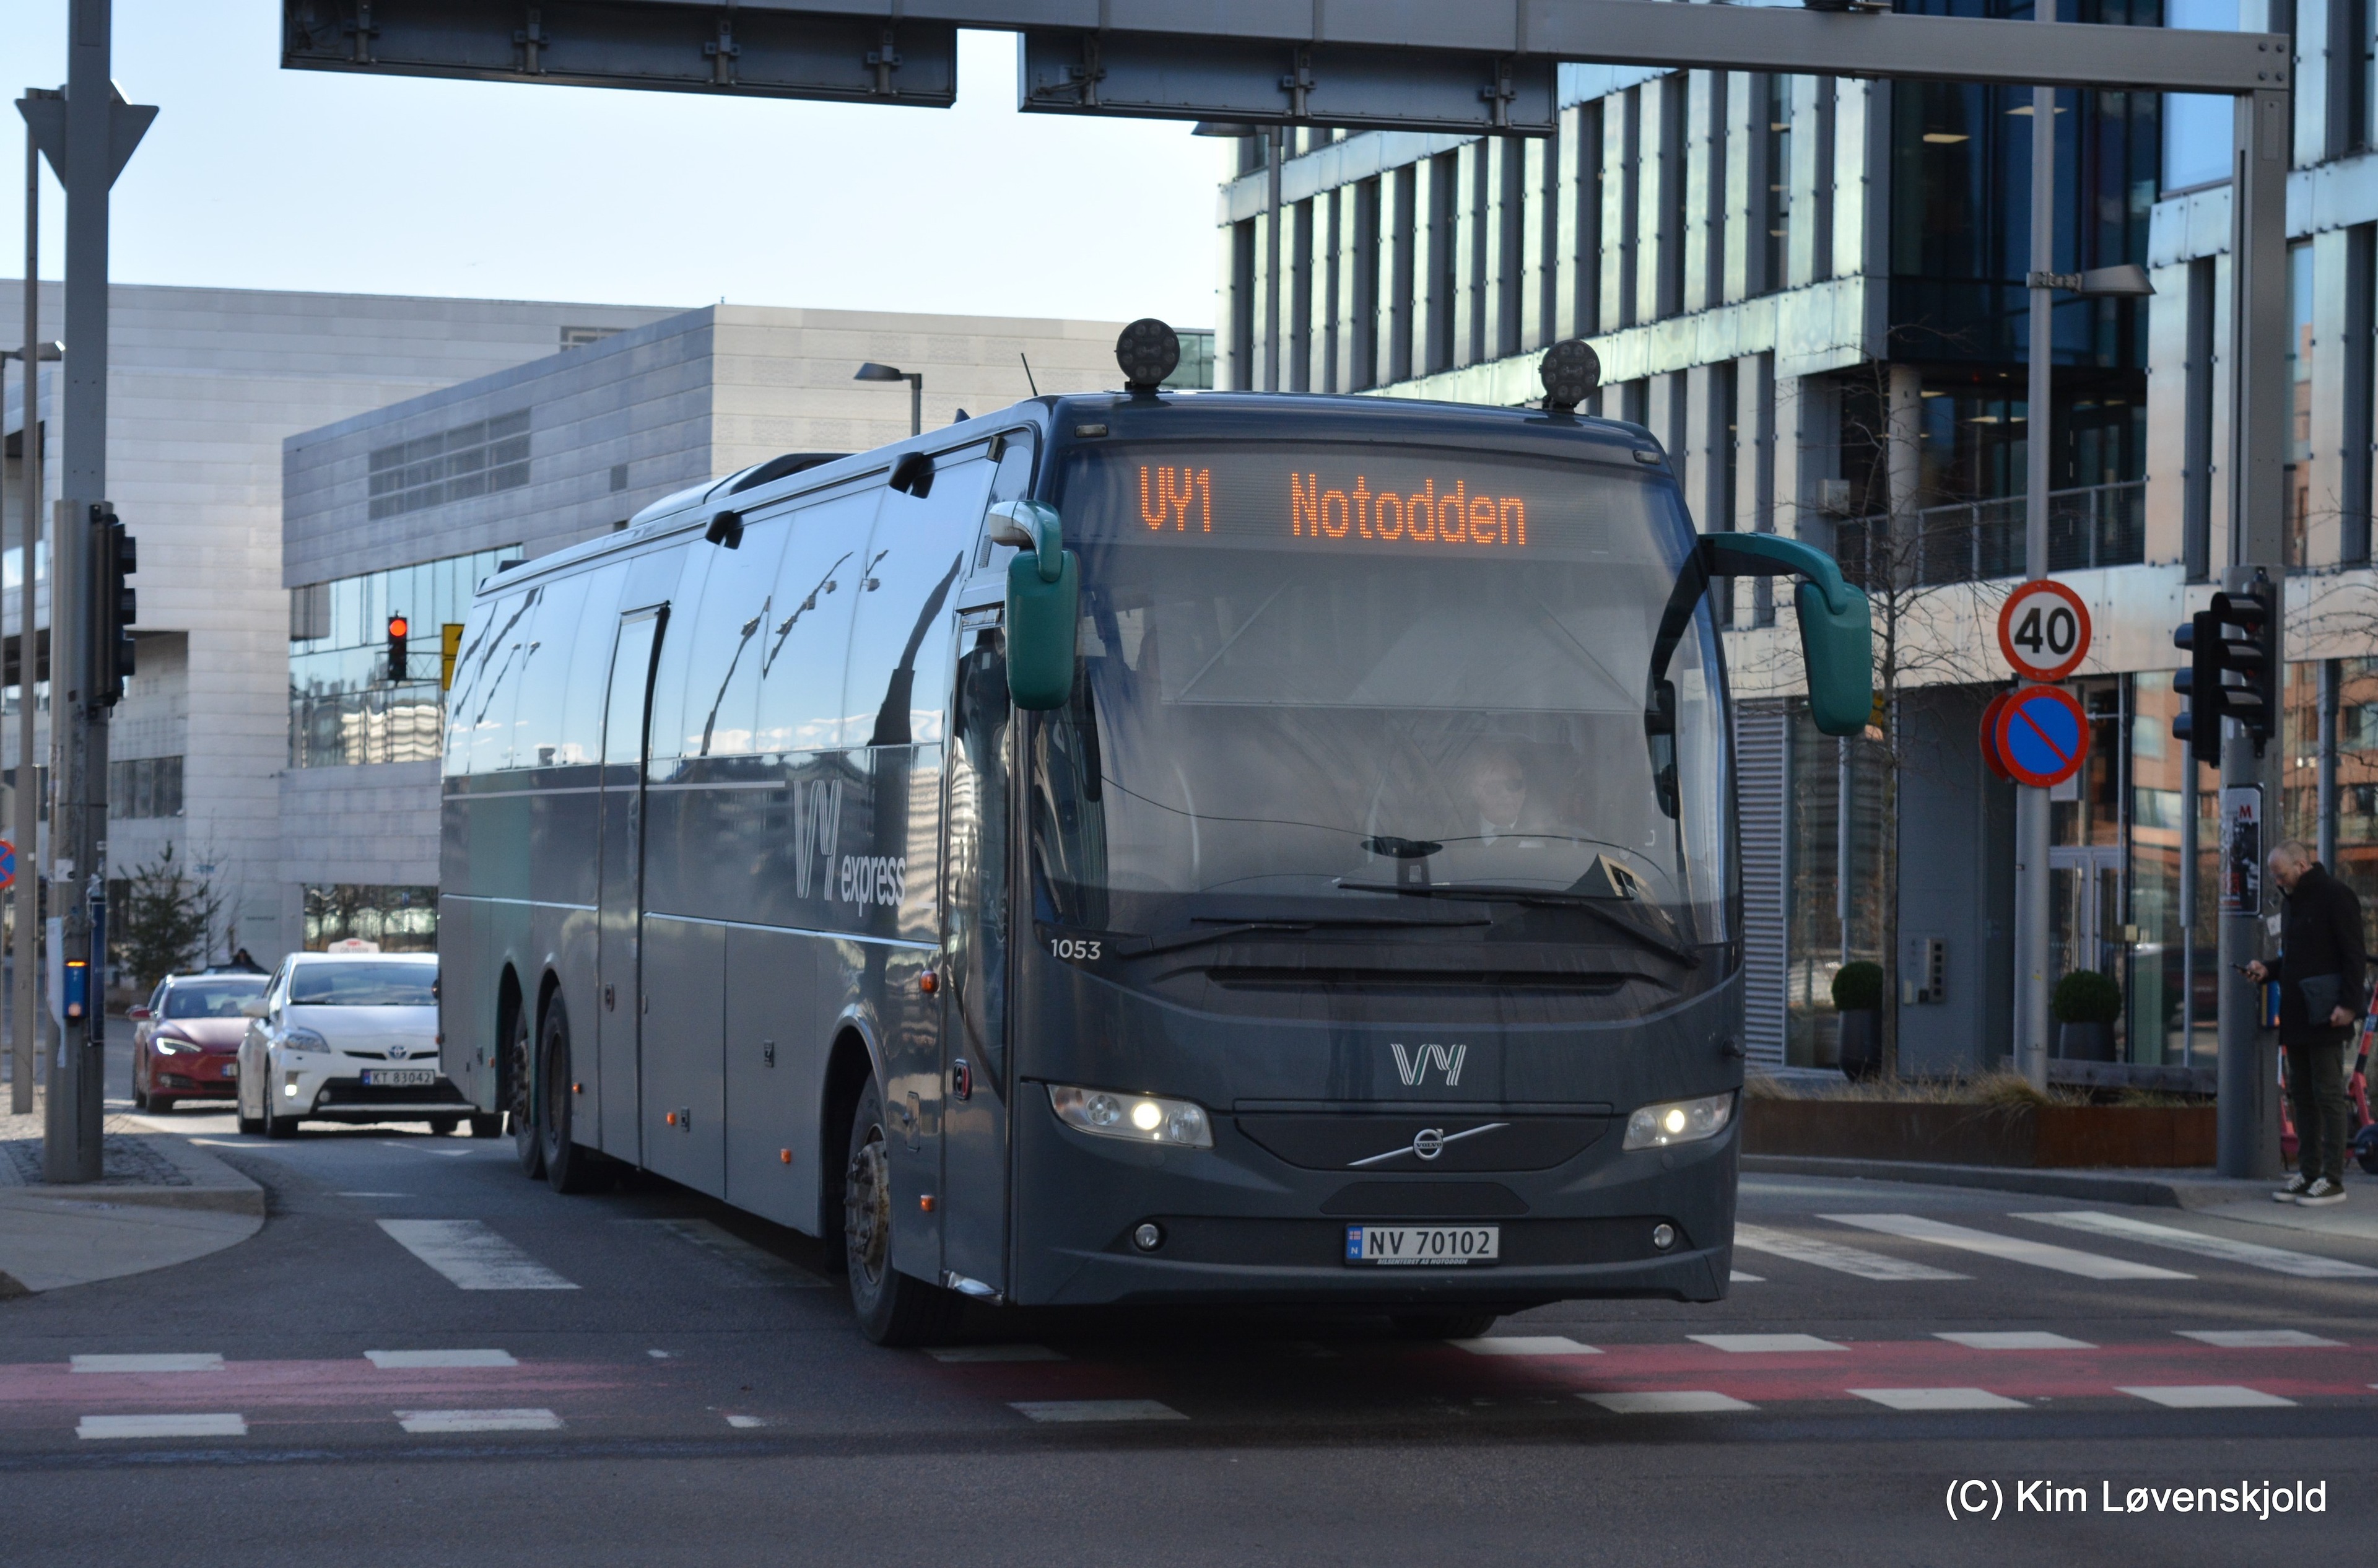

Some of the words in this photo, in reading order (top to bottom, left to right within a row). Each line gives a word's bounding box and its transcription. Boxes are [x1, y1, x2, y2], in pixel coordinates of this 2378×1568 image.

[1292, 473, 1525, 545] Notodden
[2014, 607, 2076, 655] 40
[841, 855, 906, 917] express
[1051, 939, 1101, 960] 1053
[393, 1072, 430, 1083] 83042
[1369, 1231, 1404, 1255] NV
[1416, 1230, 1489, 1255] 70102
